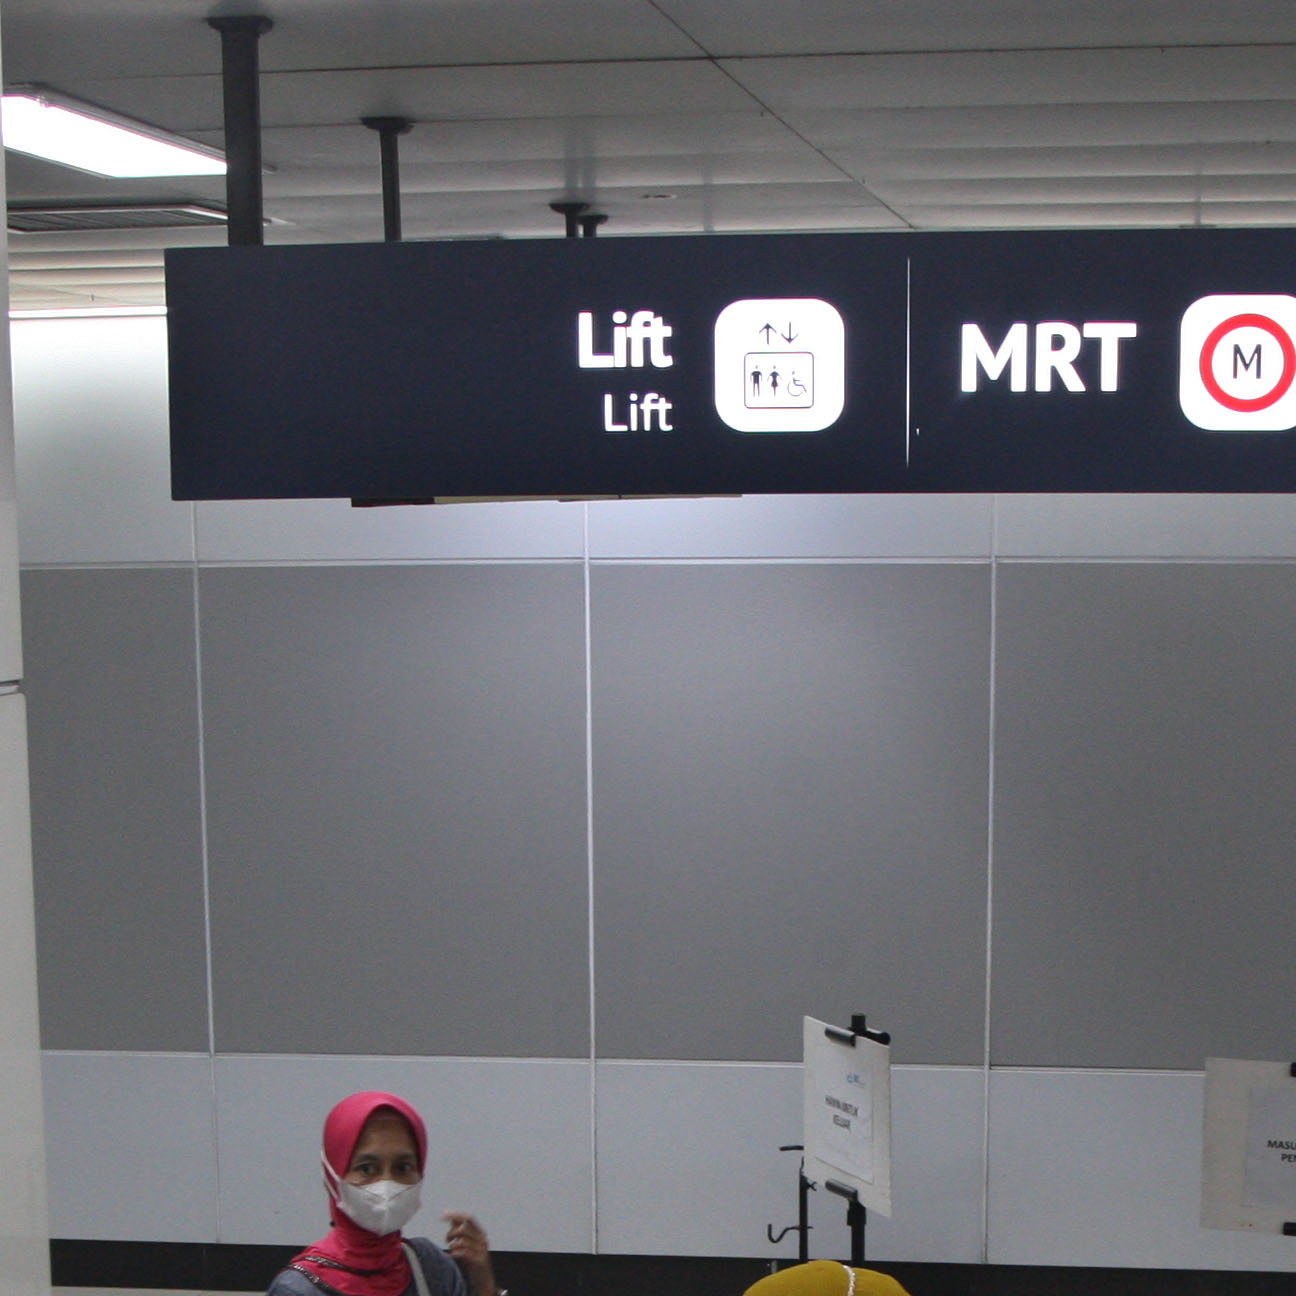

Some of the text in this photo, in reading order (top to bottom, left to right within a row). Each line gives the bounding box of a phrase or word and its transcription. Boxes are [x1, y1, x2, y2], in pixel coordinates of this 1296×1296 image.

[577, 309, 674, 369] Lift
[960, 321, 1138, 393] MRT
[1233, 343, 1262, 379] M
[604, 392, 674, 432] Lift
